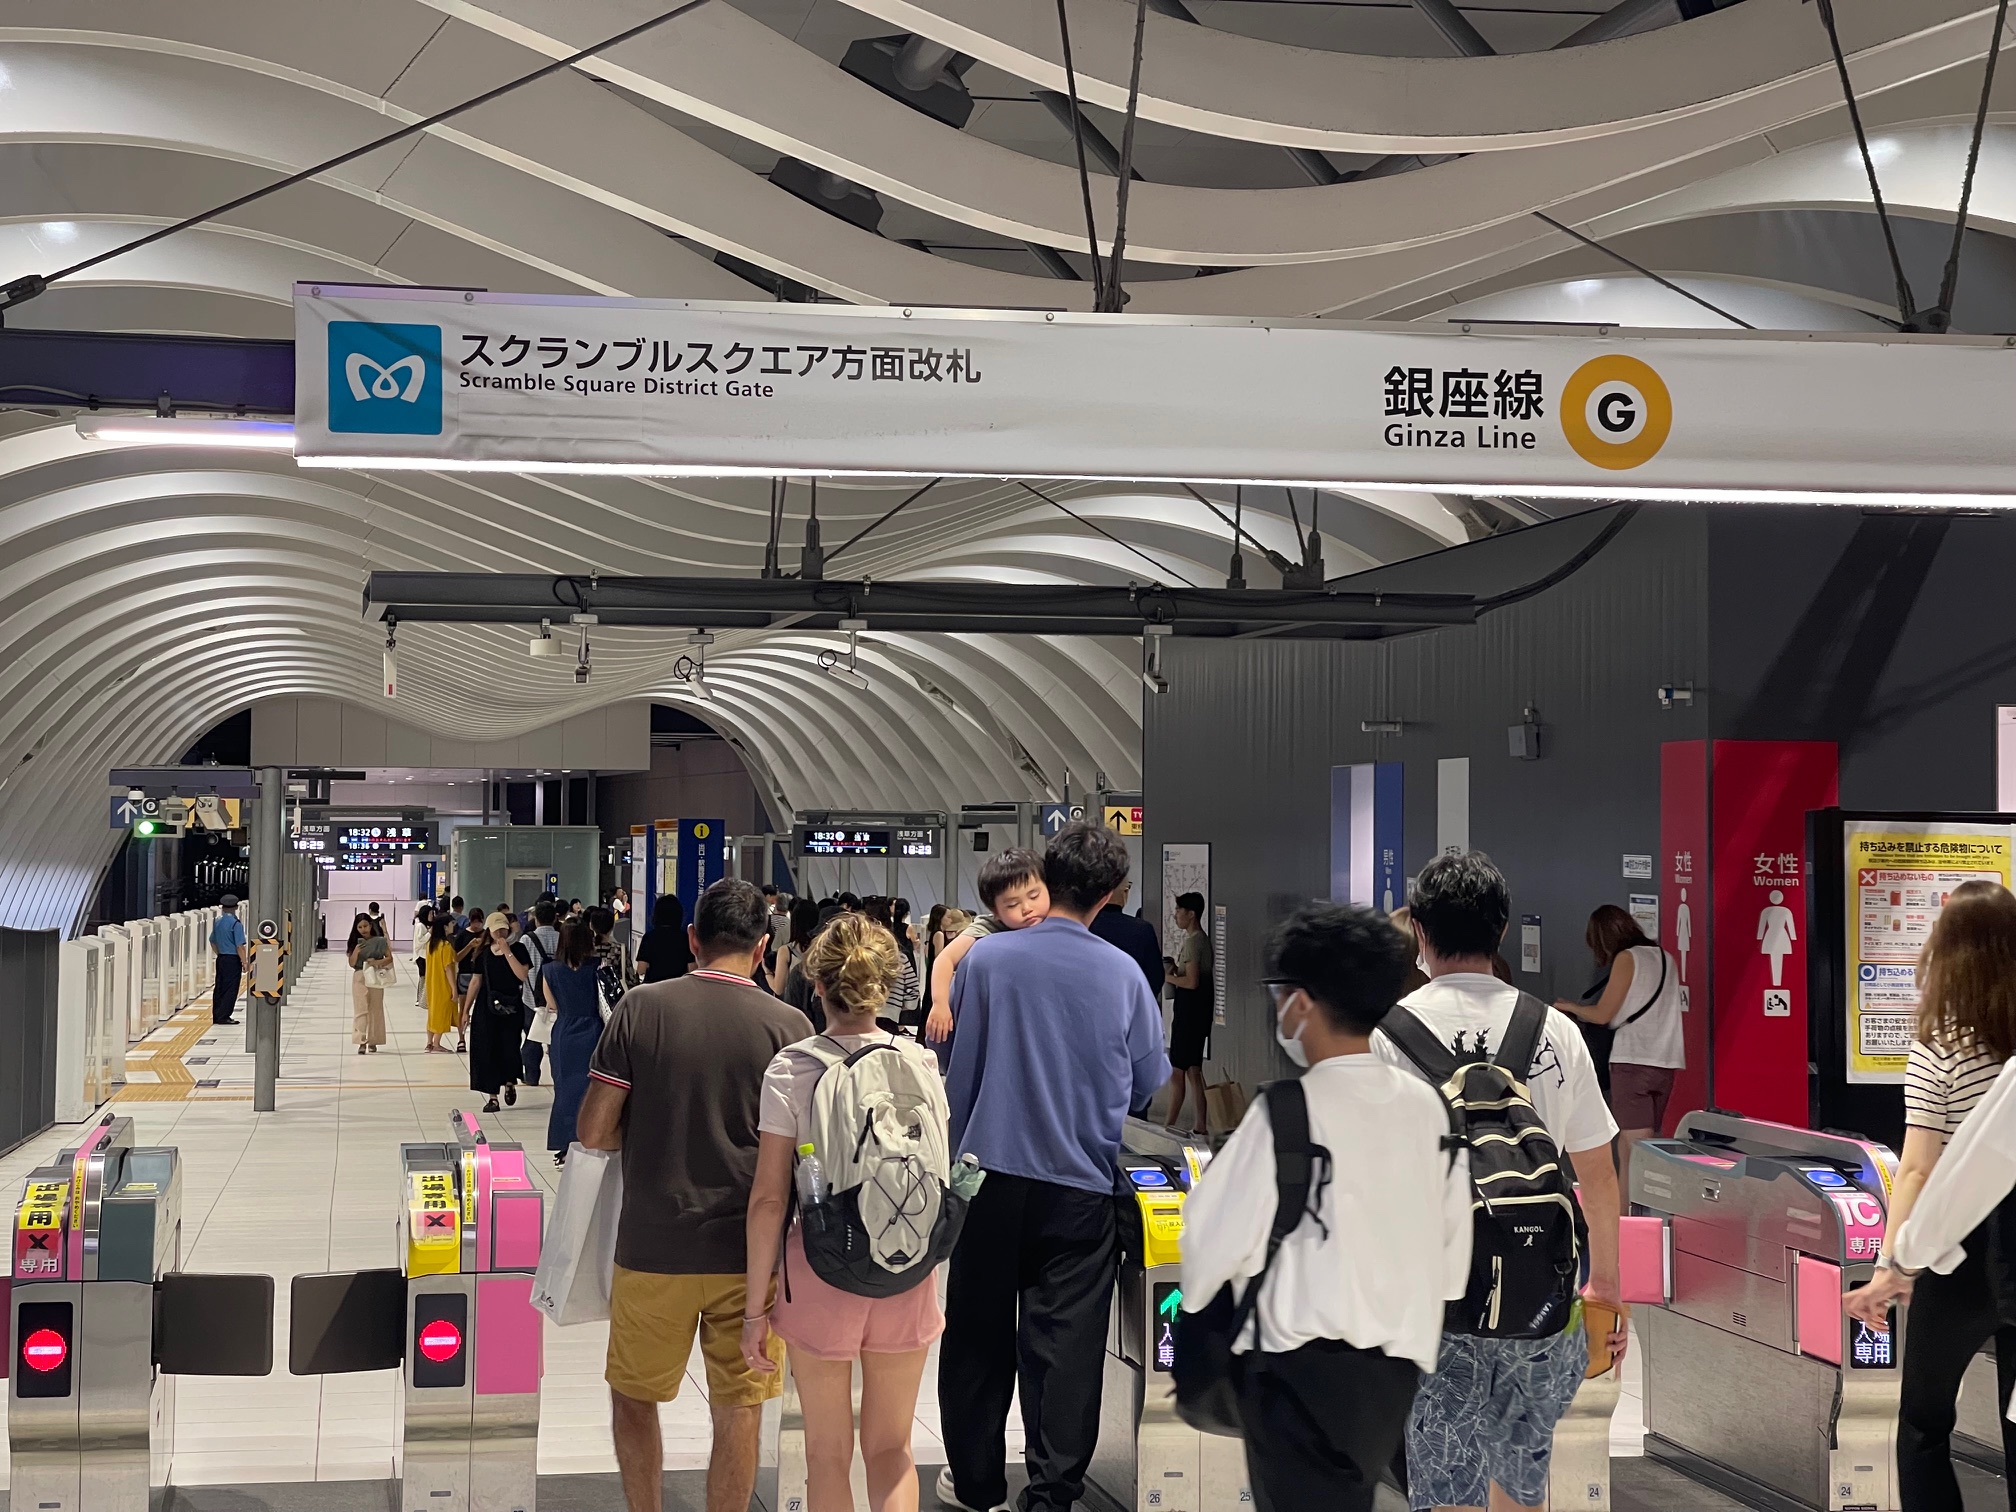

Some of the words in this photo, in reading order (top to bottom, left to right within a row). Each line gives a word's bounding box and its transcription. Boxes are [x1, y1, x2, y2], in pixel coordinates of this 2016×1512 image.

[461, 334, 981, 383] スクランブルスクエア方面改札
[460, 372, 555, 391] Scramble
[564, 374, 636, 396] Square
[644, 377, 718, 396] District
[725, 380, 774, 397] Gate
[1383, 366, 1544, 420] 銀座線
[1597, 392, 1636, 433] G
[1384, 423, 1466, 448] Ginza
[1478, 425, 1537, 450] Line
[348, 828, 371, 836] 18:32
[813, 832, 835, 840] 18:32
[1859, 841, 2003, 854] 持ち込みを禁止する危険物について
[1754, 853, 1799, 874] 女性
[1753, 876, 1799, 887] Women
[1879, 872, 1934, 881] 持ち込めないもの
[1833, 1198, 1880, 1226] IC
[1513, 1225, 1544, 1233] KANGOL
[1849, 1237, 1882, 1254] 専用
[20, 1258, 58, 1273] 専用
[1854, 1342, 1890, 1364] 専用
[1240, 1492, 1251, 1501] 25
[1589, 1488, 1599, 1497] 24
[1841, 1487, 1851, 1496] 24
[1149, 1494, 1160, 1503] 26
[789, 1501, 800, 1511] 27
